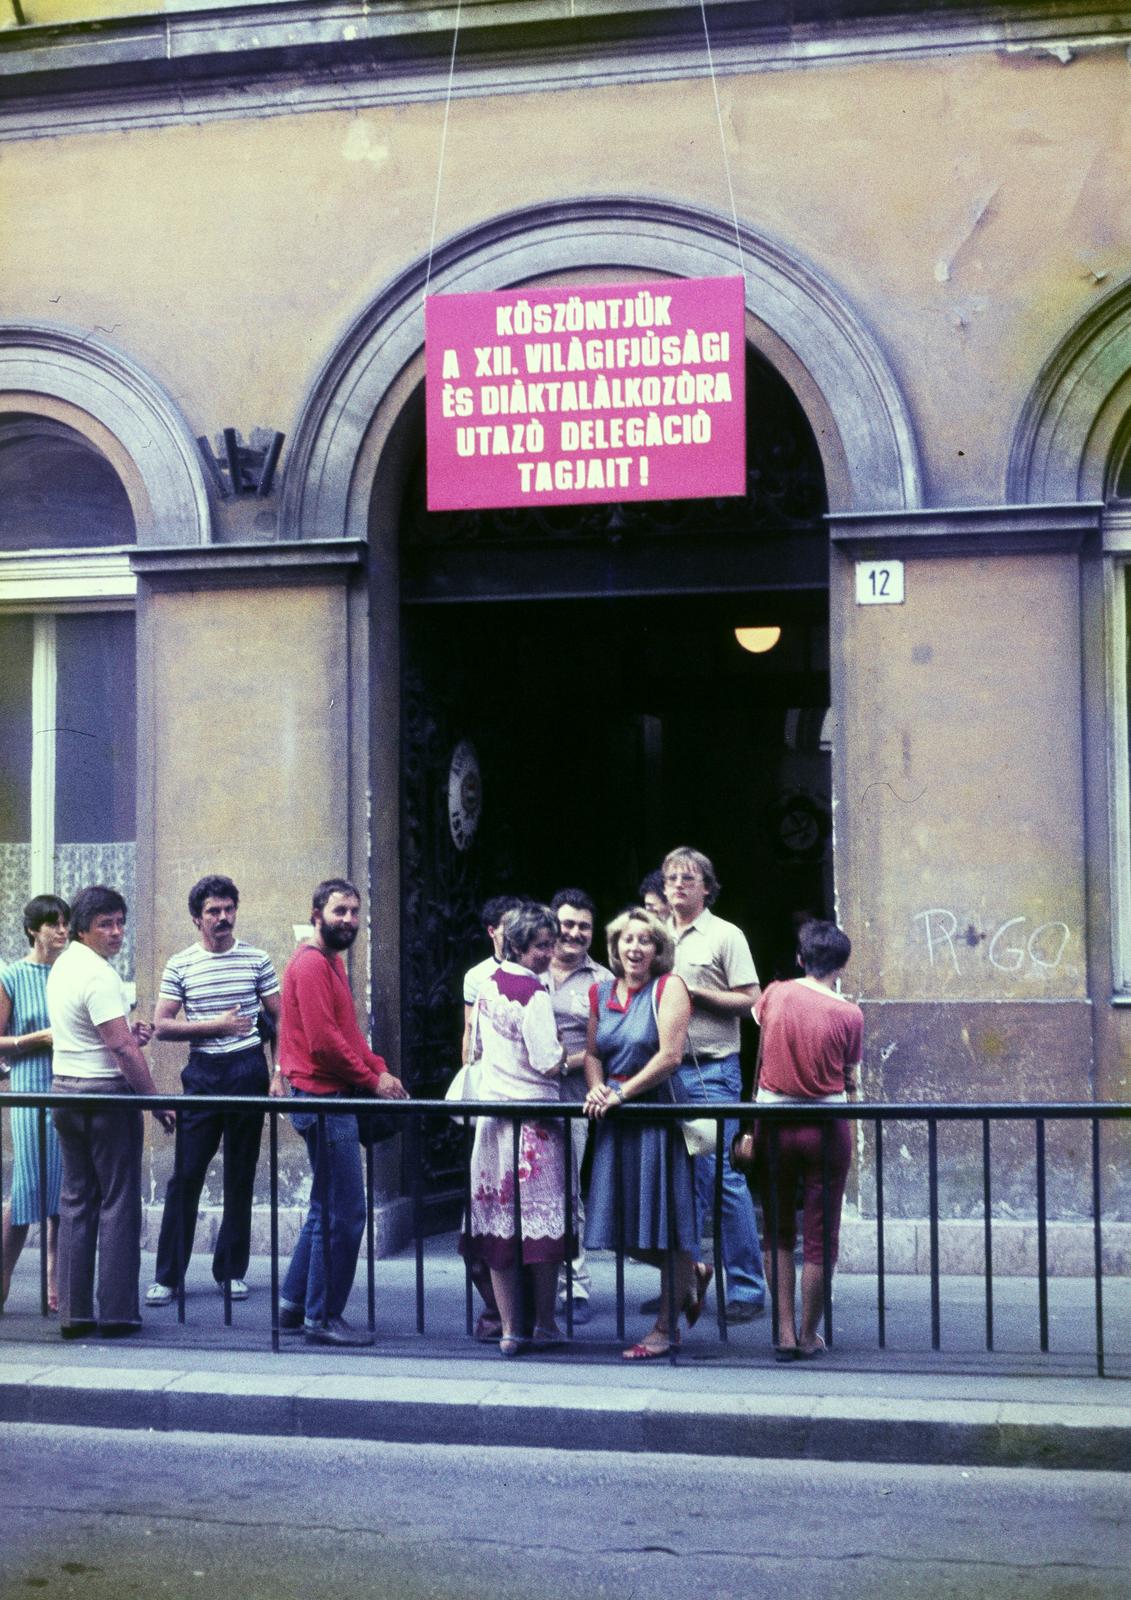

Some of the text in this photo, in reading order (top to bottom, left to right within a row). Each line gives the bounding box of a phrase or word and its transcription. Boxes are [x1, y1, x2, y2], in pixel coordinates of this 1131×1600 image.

[495, 291, 672, 336] KÖSZÖNTJÜK
[441, 349, 460, 379] A
[474, 346, 518, 377] XII.
[869, 569, 890, 596] 12
